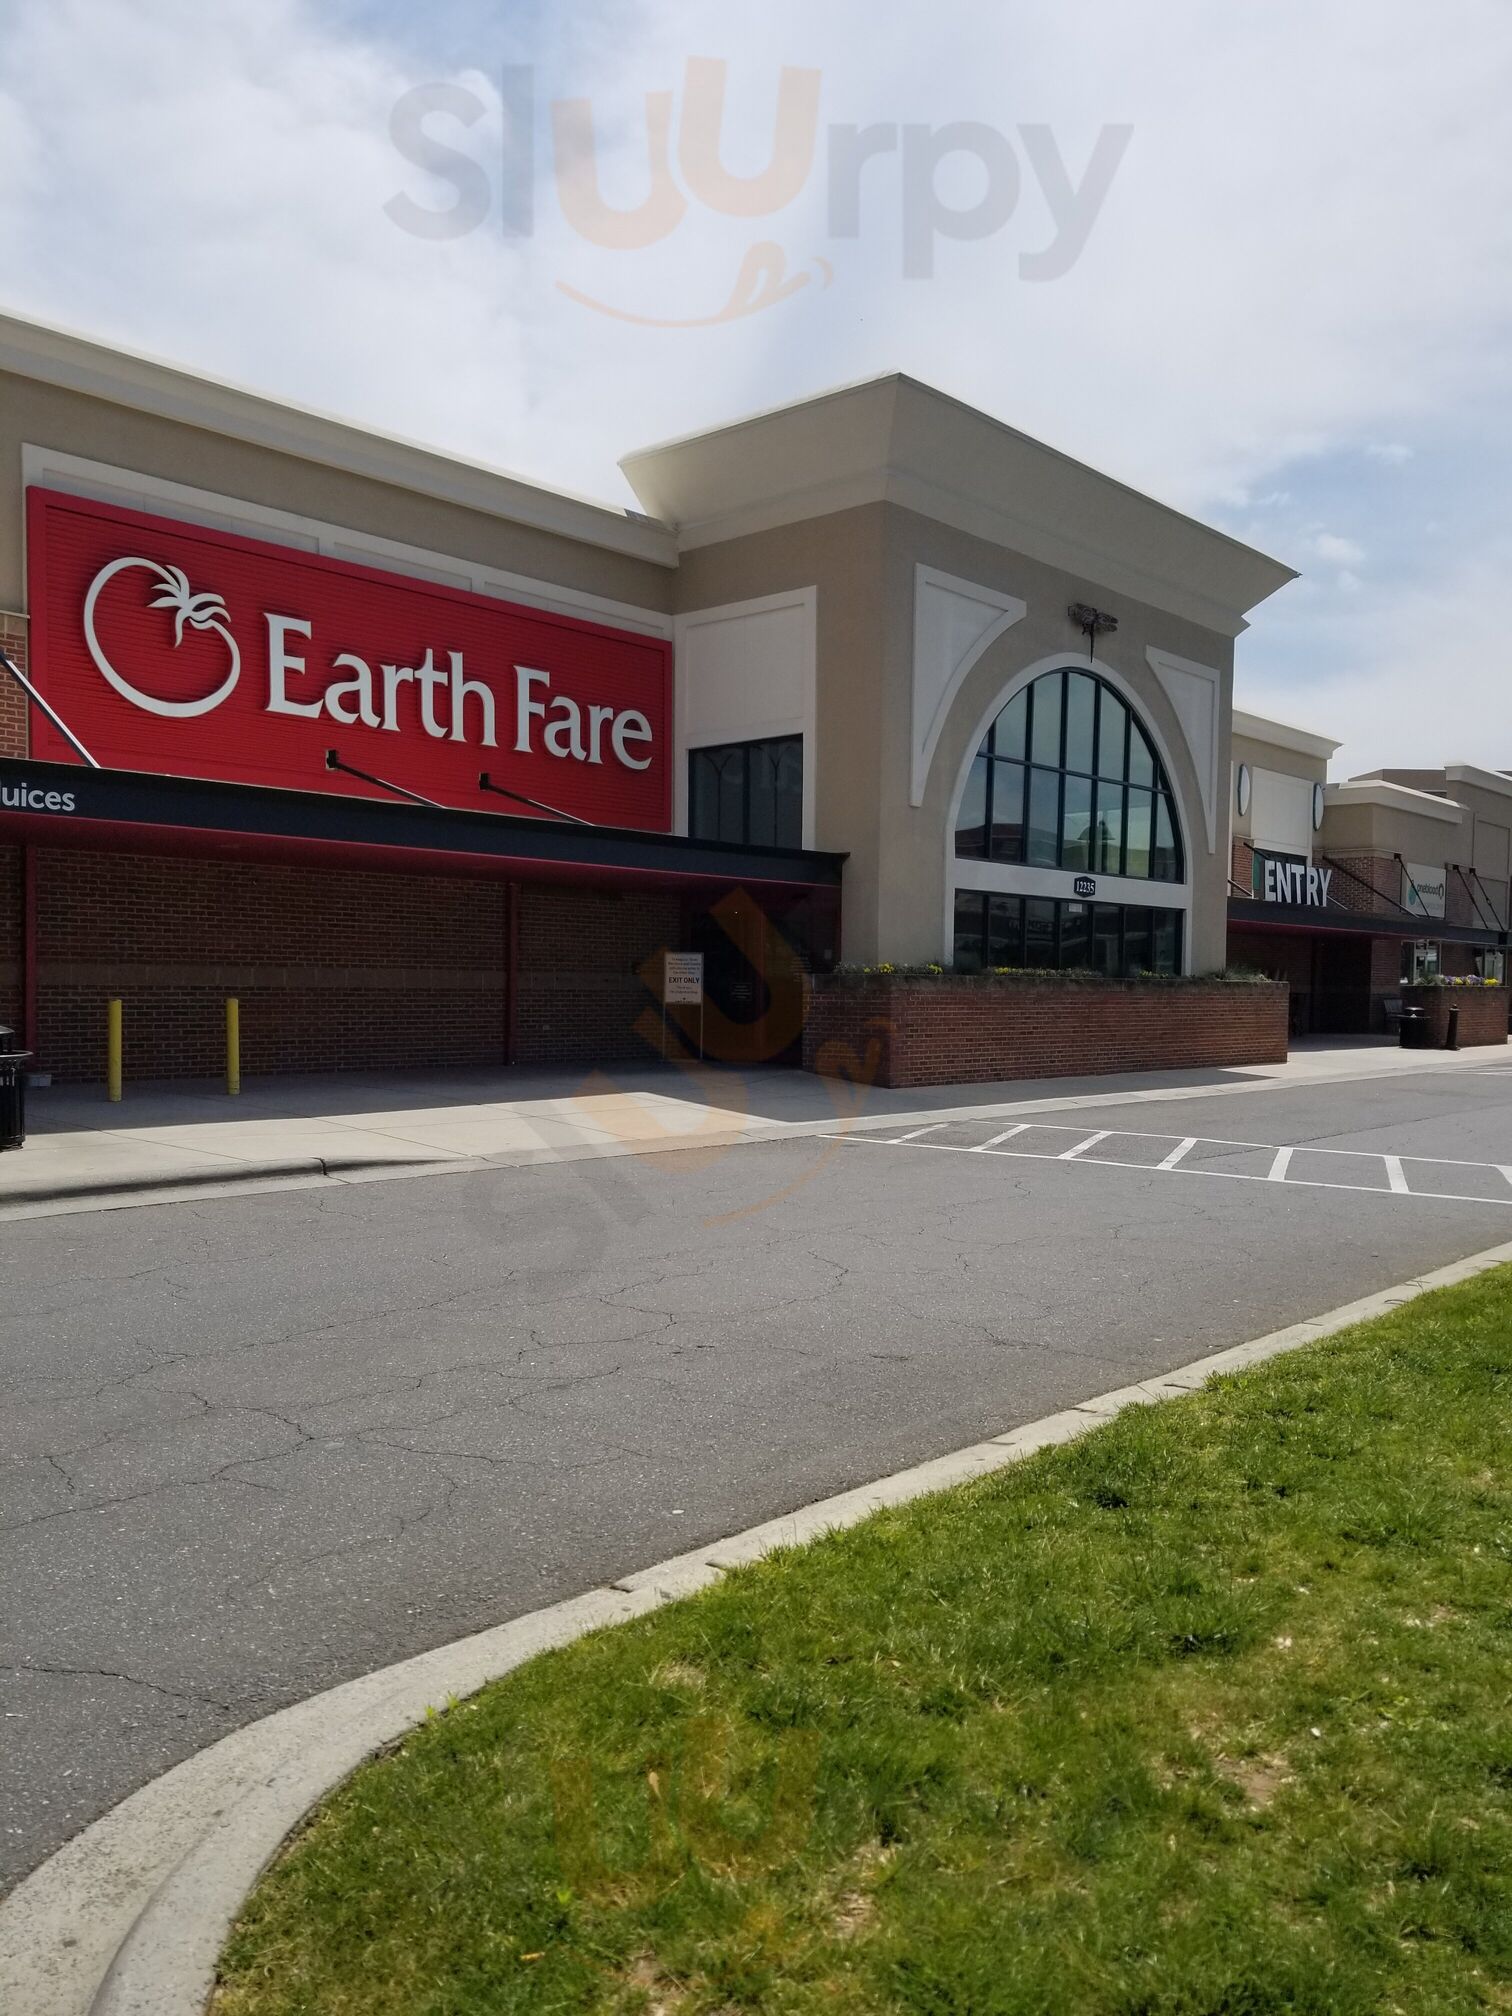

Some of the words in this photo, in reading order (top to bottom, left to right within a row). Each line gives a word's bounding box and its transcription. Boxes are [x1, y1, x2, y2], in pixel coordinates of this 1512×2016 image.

[264, 612, 497, 748] Earth
[512, 664, 654, 771] Fare
[0, 781, 76, 812] uices
[1076, 880, 1095, 894] 12235
[1264, 859, 1332, 907] ENTRY
[668, 976, 682, 984] EXIT
[683, 976, 700, 984] ONLY
